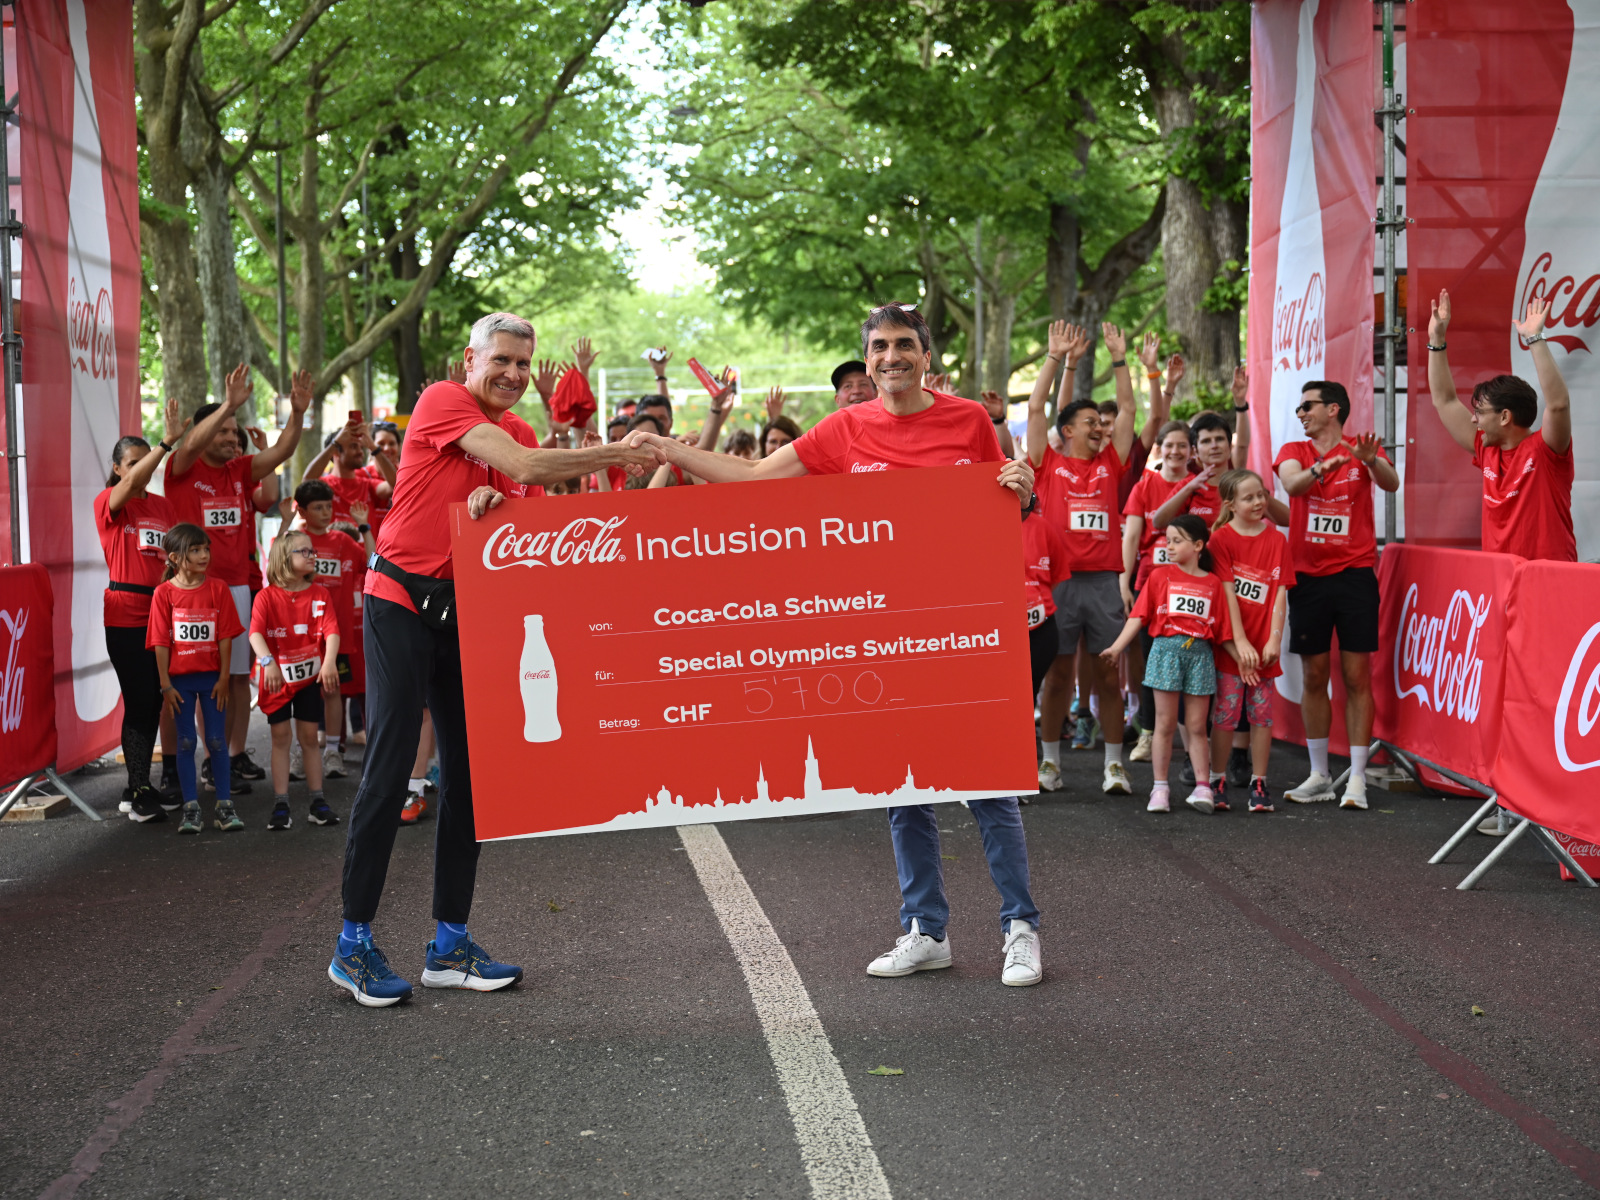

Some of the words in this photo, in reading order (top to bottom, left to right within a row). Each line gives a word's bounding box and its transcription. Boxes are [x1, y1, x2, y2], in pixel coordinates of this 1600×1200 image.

[211, 511, 236, 525] 334
[1077, 514, 1103, 529] 171
[1313, 516, 1342, 534] 170
[636, 523, 807, 560] Inclusion
[820, 518, 894, 546] Run
[589, 623, 613, 632] von:
[653, 600, 779, 626] Coca-Cola
[785, 591, 887, 615] Schweiz
[1176, 597, 1205, 615] 298
[179, 624, 210, 640] 309
[595, 670, 614, 681] für:
[659, 650, 744, 676] Special
[749, 642, 857, 668] Olympics
[863, 629, 1000, 657] Switzerland
[1394, 583, 1492, 724] Coca-Cola
[285, 661, 314, 681] 157
[599, 718, 641, 729] Betrag:
[663, 703, 712, 723] CHF
